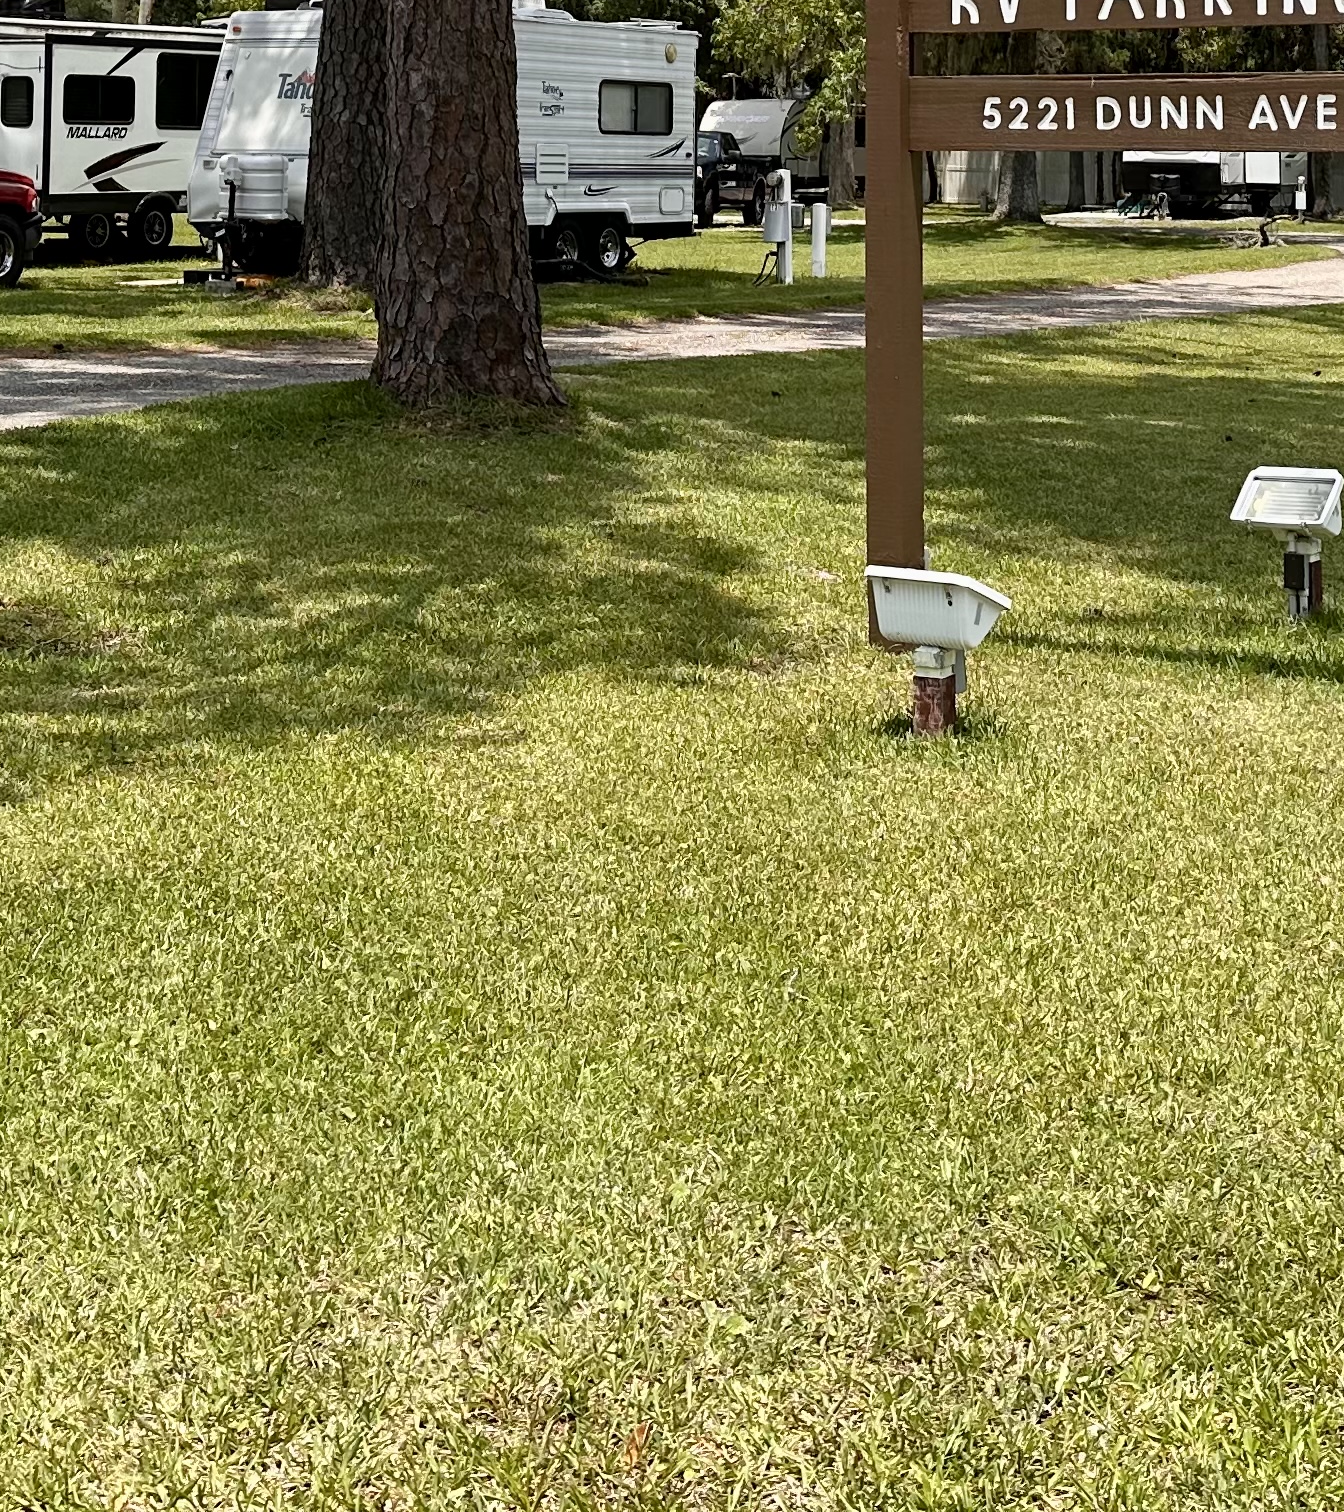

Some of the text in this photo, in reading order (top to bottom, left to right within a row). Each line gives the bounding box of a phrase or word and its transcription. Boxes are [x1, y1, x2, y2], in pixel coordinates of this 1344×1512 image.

[982, 93, 1337, 132] 5221 DUNN AVE
[66, 126, 129, 139] MALLARD
